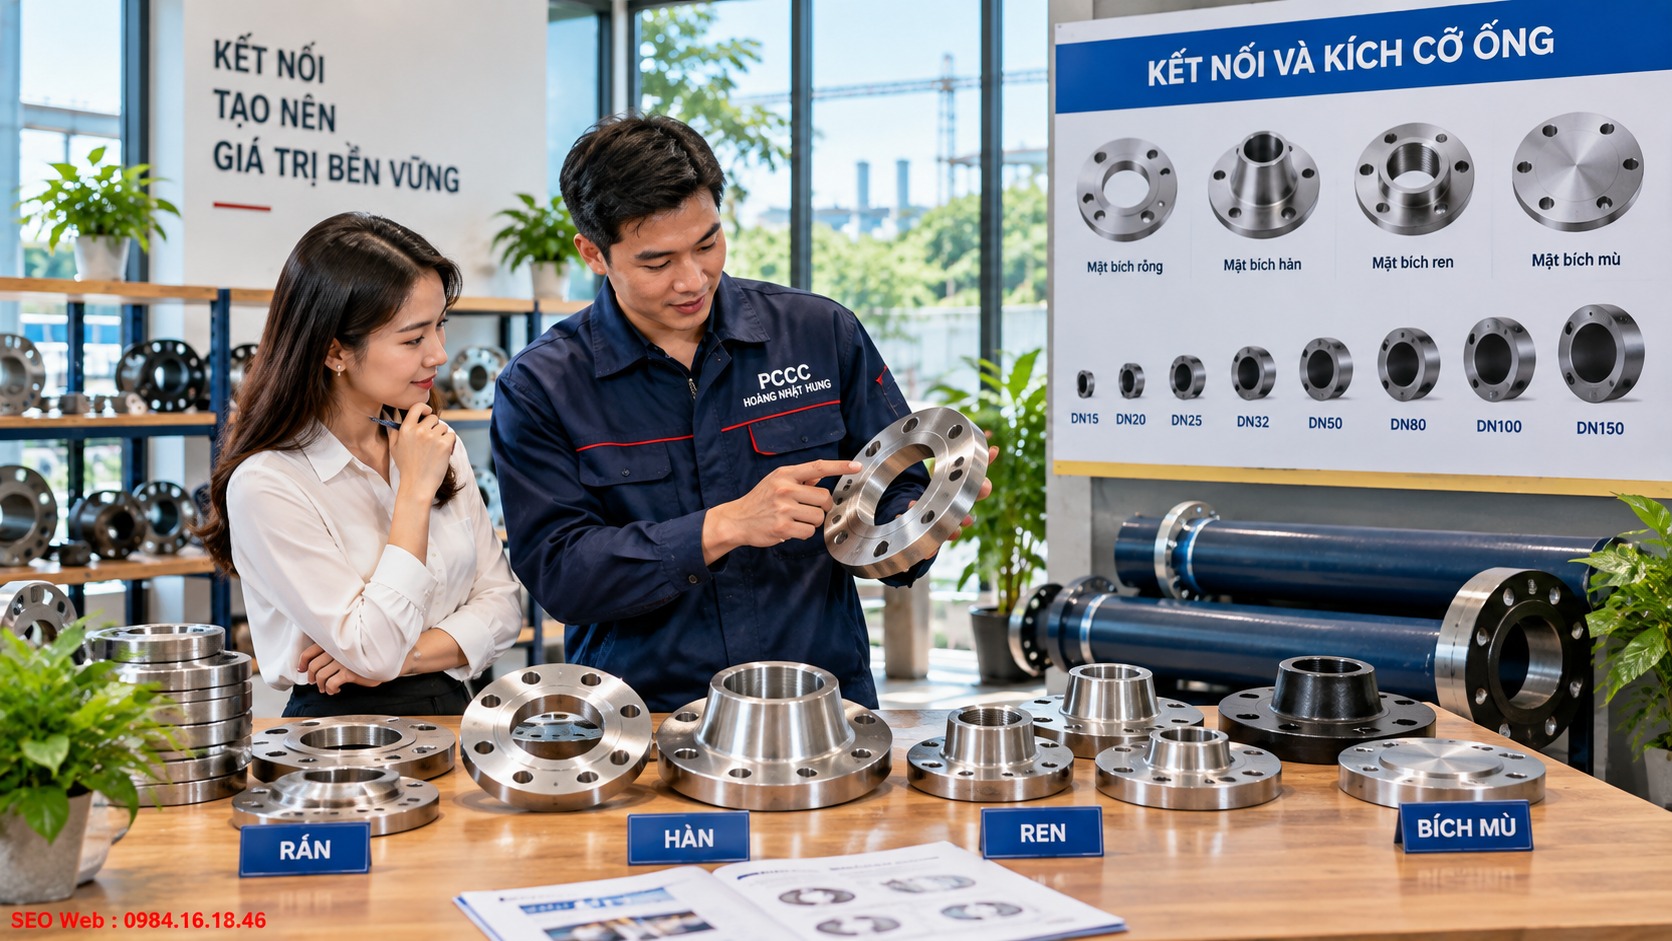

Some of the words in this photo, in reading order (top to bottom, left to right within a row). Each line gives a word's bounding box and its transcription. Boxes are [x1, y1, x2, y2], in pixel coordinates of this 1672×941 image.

[213, 33, 268, 74] KẾT
[277, 42, 325, 83] NỐI
[1148, 48, 1203, 86] KẾT
[1211, 42, 1265, 81] NỐI
[1273, 40, 1316, 76] VÀ
[1324, 35, 1402, 72] KÍCH
[1413, 26, 1464, 64] CỠ
[1473, 19, 1554, 60] ỐNG
[213, 89, 270, 128] TẠO
[281, 94, 336, 132] NÊN
[213, 137, 264, 174] GIÁ
[274, 147, 317, 186] TRỊ
[328, 142, 380, 185] BỀN
[389, 156, 459, 193] VỮNG
[1250, 258, 1275, 271] bích
[1401, 255, 1428, 269] bích
[1432, 257, 1454, 268] ren
[1563, 252, 1594, 266] bích
[1598, 251, 1621, 266] mù
[1110, 260, 1135, 273] bích
[757, 364, 811, 389] PCCC
[805, 379, 832, 393] HUNG
[1071, 413, 1099, 424] DN15
[1116, 413, 1146, 425] DN20
[1171, 414, 1203, 426] DN25
[1237, 415, 1269, 428] DN32
[1308, 417, 1343, 430] DN50
[1390, 418, 1427, 431] DN80
[1476, 420, 1522, 433] DN100
[1576, 421, 1625, 435] DN150
[1417, 813, 1473, 838] BÍCH
[1480, 812, 1516, 837] MÙ
[664, 824, 714, 849] HÀN
[1020, 823, 1066, 843] REN
